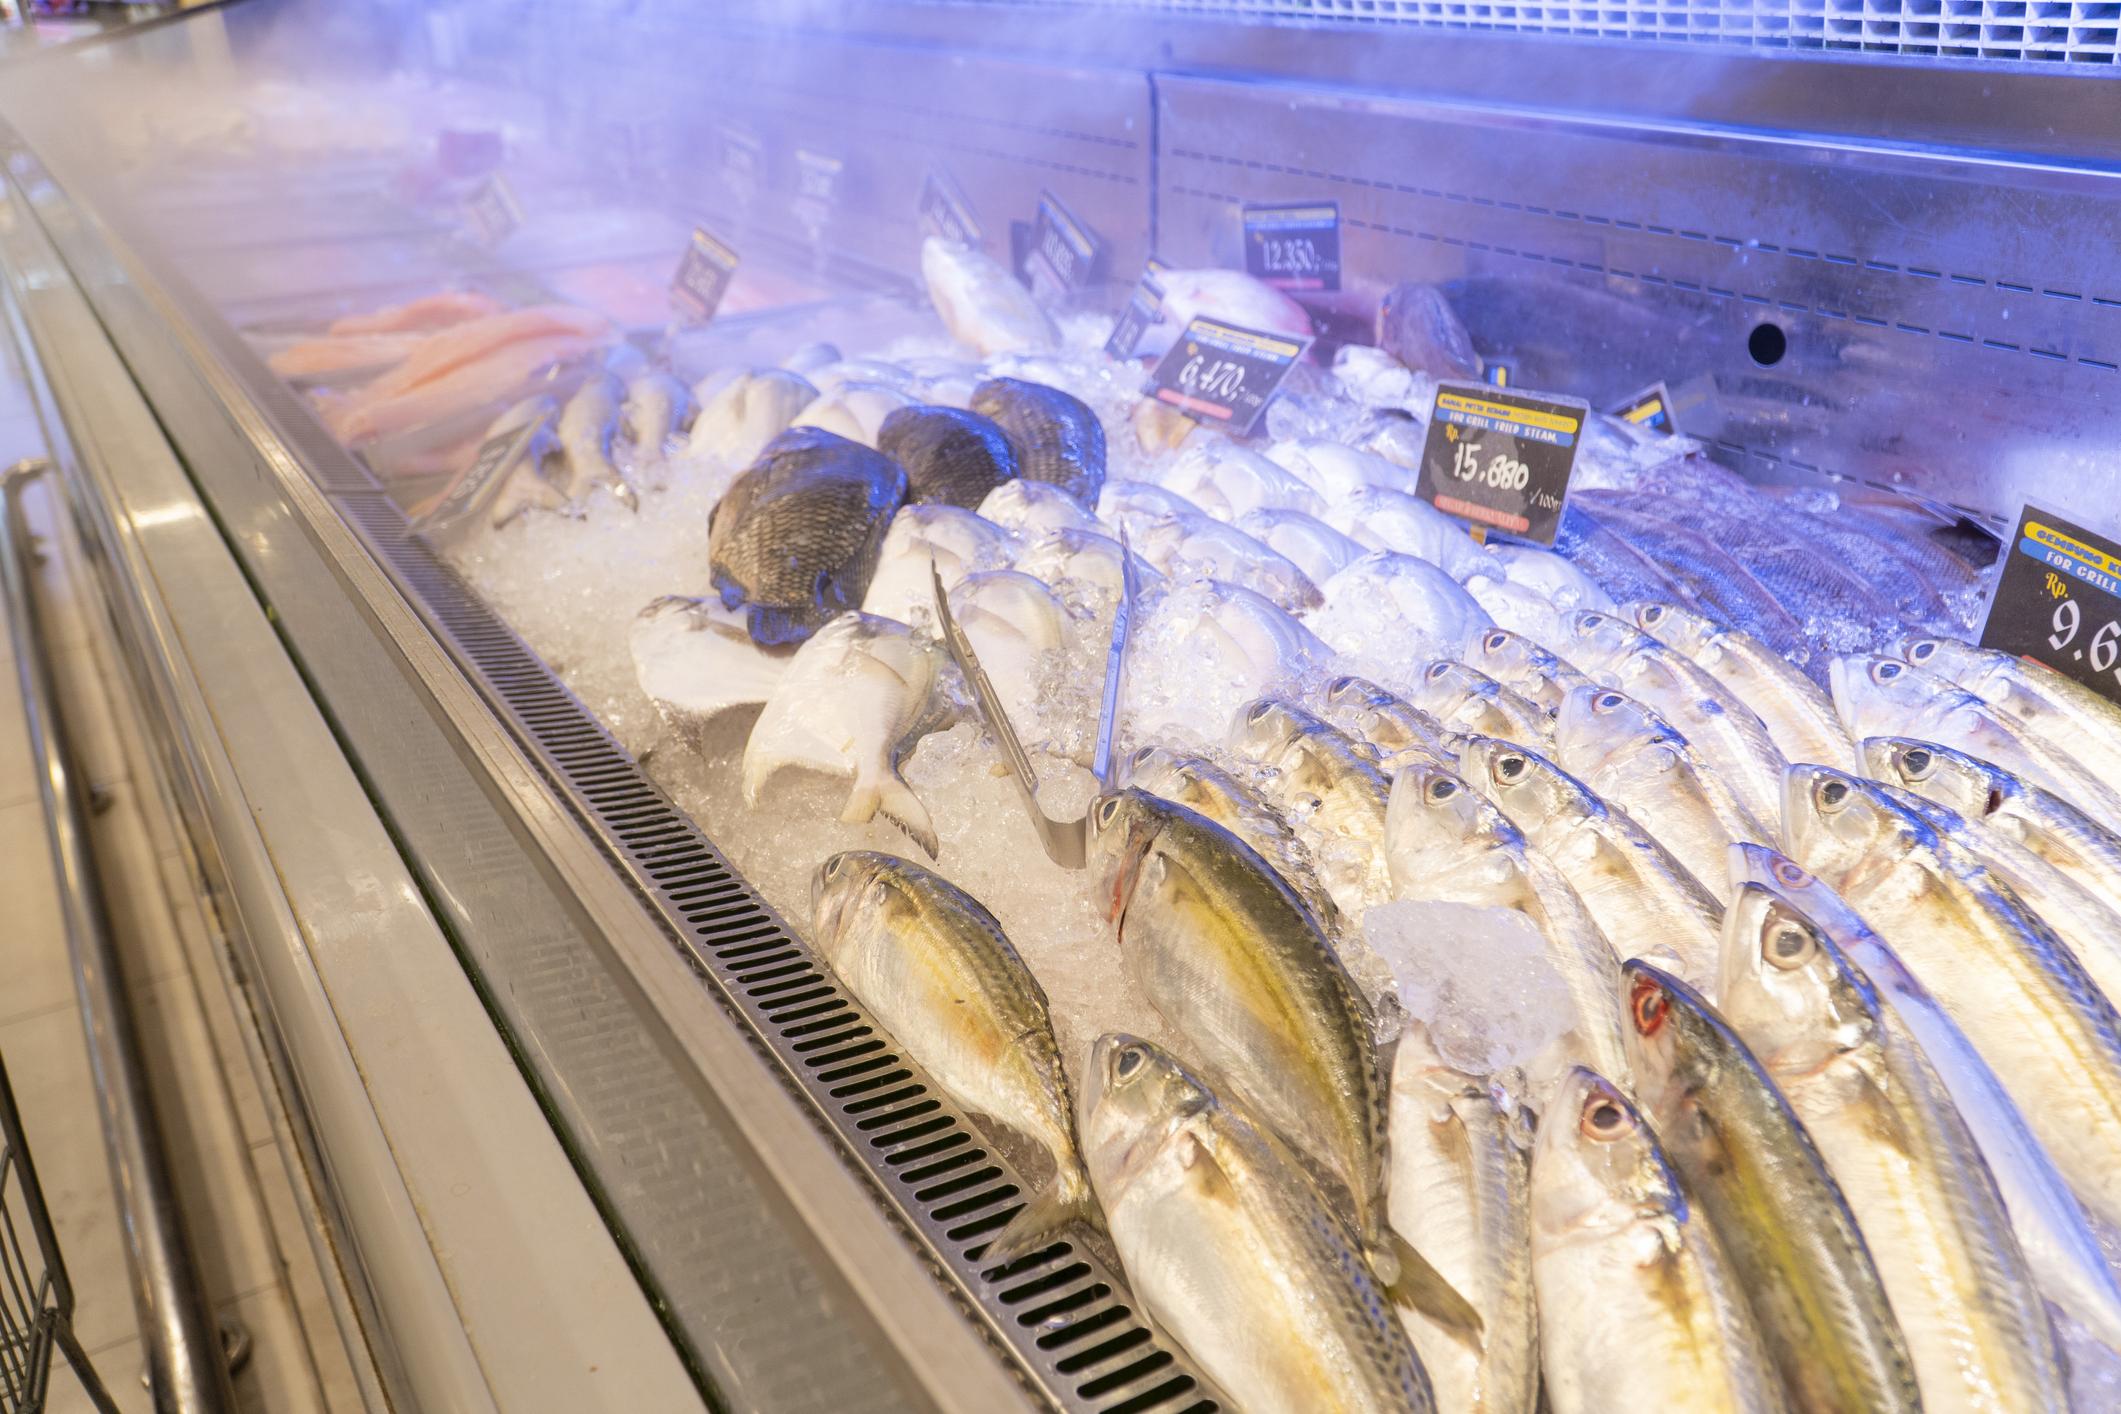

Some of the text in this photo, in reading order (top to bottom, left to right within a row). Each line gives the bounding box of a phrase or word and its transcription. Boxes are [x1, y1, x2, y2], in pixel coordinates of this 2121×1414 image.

[2045, 551, 2118, 593] FOR GRILL
[2045, 572, 2069, 600] Rp.
[2048, 599, 2121, 686] 9.6
